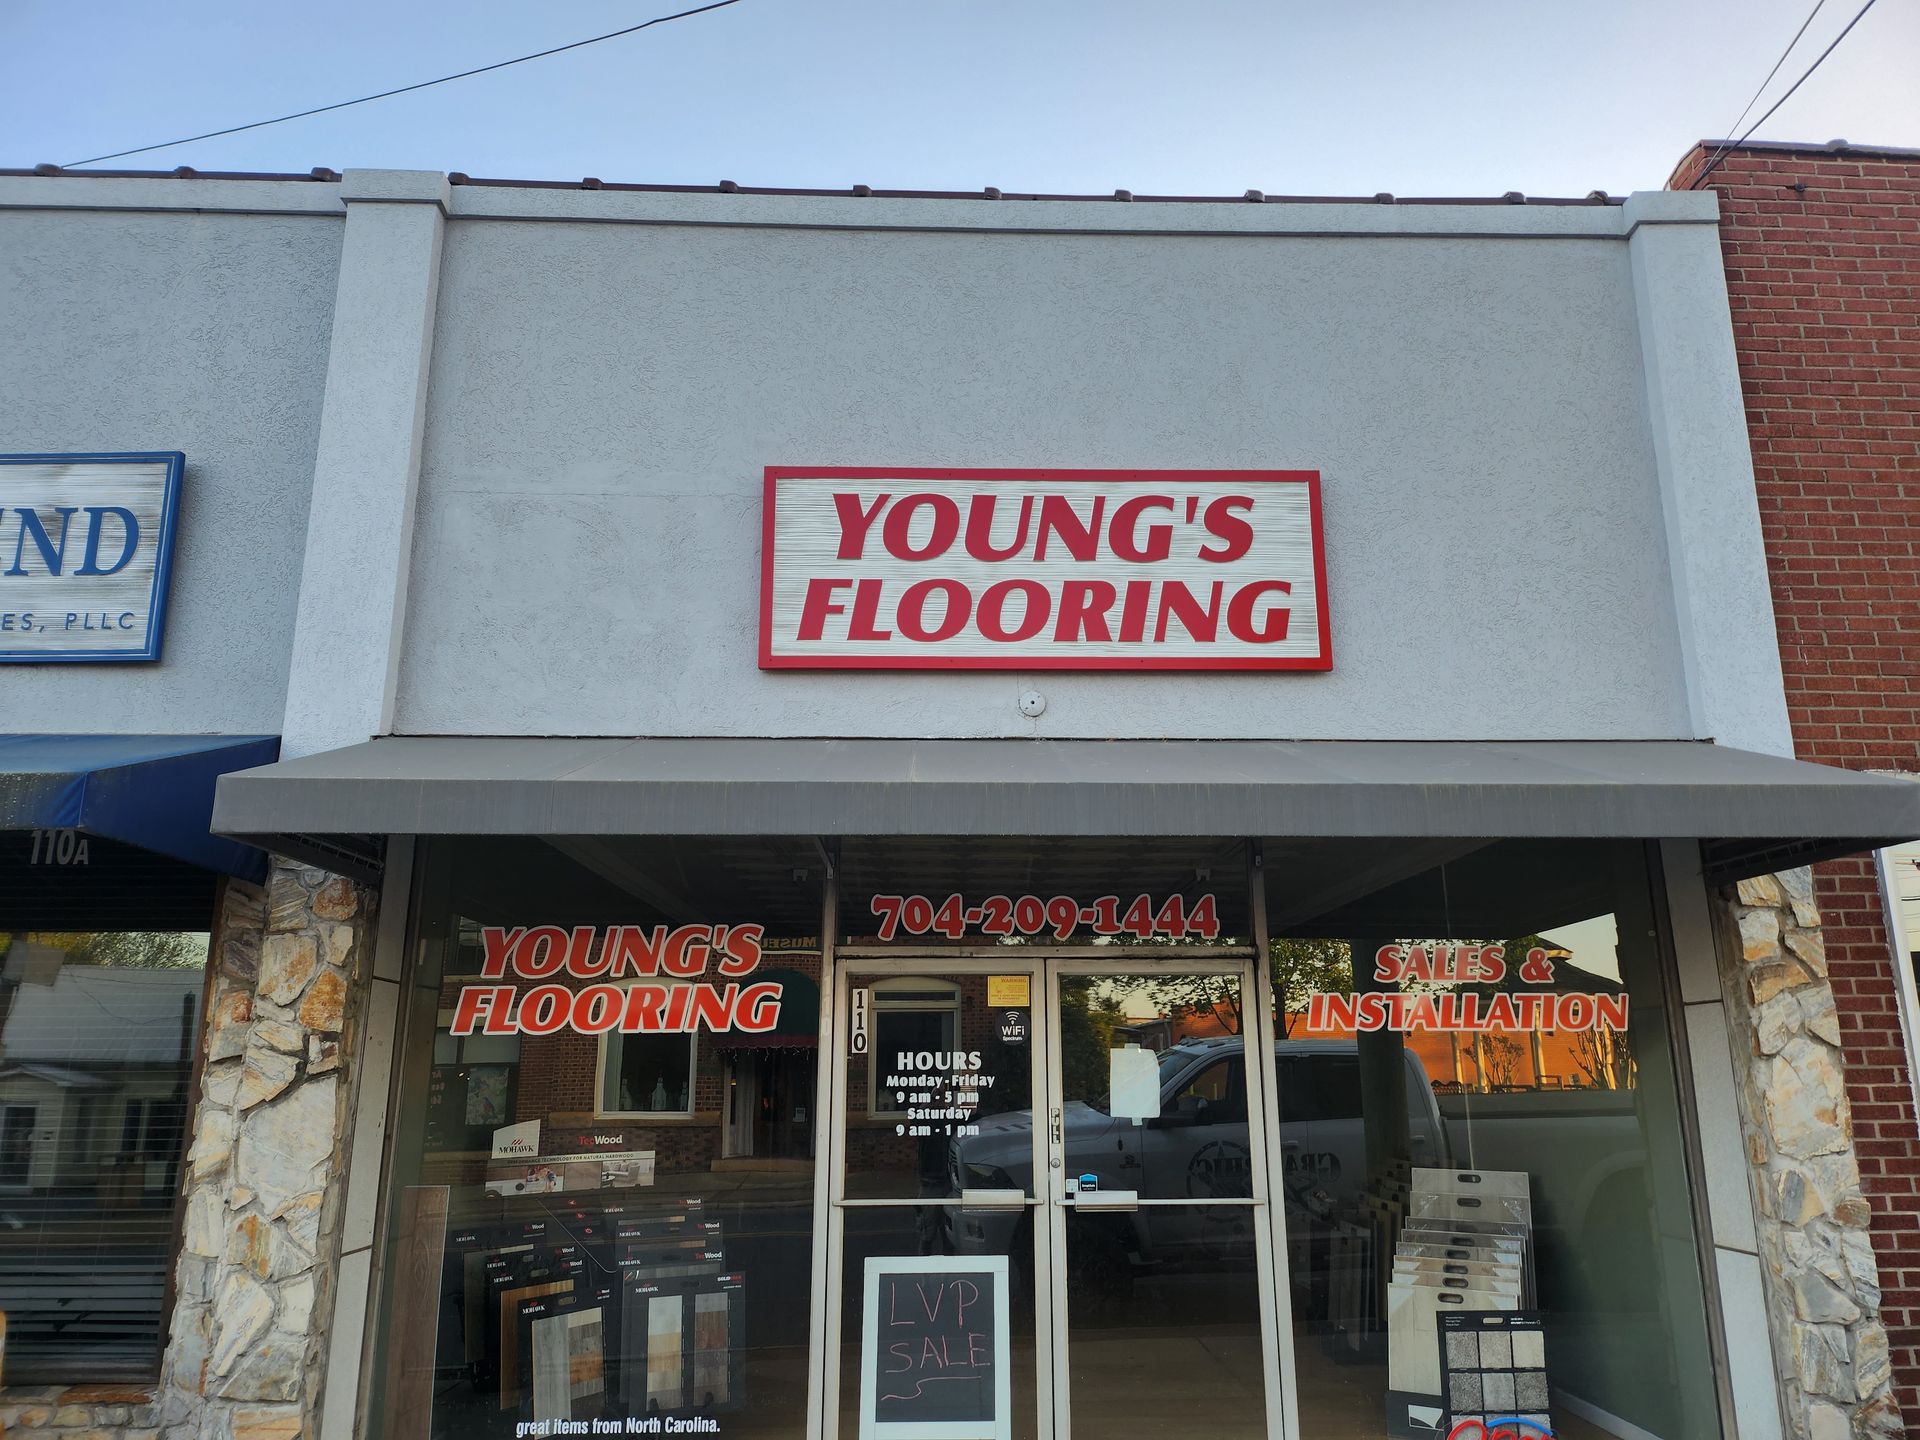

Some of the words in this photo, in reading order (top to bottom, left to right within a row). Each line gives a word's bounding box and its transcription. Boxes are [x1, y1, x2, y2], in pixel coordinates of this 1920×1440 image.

[0, 506, 140, 577] ND
[832, 492, 1255, 563] YOUNG'S
[2, 613, 46, 633] ES,
[65, 612, 136, 631] PLLC
[796, 578, 1292, 643] FLOORING
[31, 828, 89, 866] 110A
[870, 892, 1220, 942] 704-209-1444
[480, 923, 765, 979] YOUNG'S
[1373, 944, 1508, 984] SALES
[1519, 946, 1556, 985] &
[450, 982, 783, 1036] FLOORING
[853, 990, 867, 1052] 110
[1306, 991, 1631, 1033] INSTALLATION
[1001, 1025, 1025, 1036] WiFi
[897, 1051, 983, 1071] HOURS
[896, 1091, 905, 1104] 9
[909, 1093, 931, 1103] am
[945, 1091, 953, 1103] 5
[957, 1092, 980, 1105] pm
[907, 1107, 971, 1121] Saturday
[896, 1124, 905, 1136] 9
[909, 1126, 931, 1136] am
[945, 1124, 952, 1136] 1
[957, 1125, 980, 1138] pm
[1050, 1108, 1061, 1145] PULL
[499, 1143, 534, 1155] MOHAWK
[541, 1156, 573, 1164] TECHNOLOGY
[605, 1152, 634, 1160] HARDWOOD
[890, 1279, 980, 1329] LVP
[885, 1332, 991, 1374] SALE
[516, 1418, 551, 1438] great
[553, 1418, 589, 1435] items
[592, 1417, 623, 1435] from
[626, 1416, 661, 1434] North
[665, 1416, 721, 1434] Carolina.
